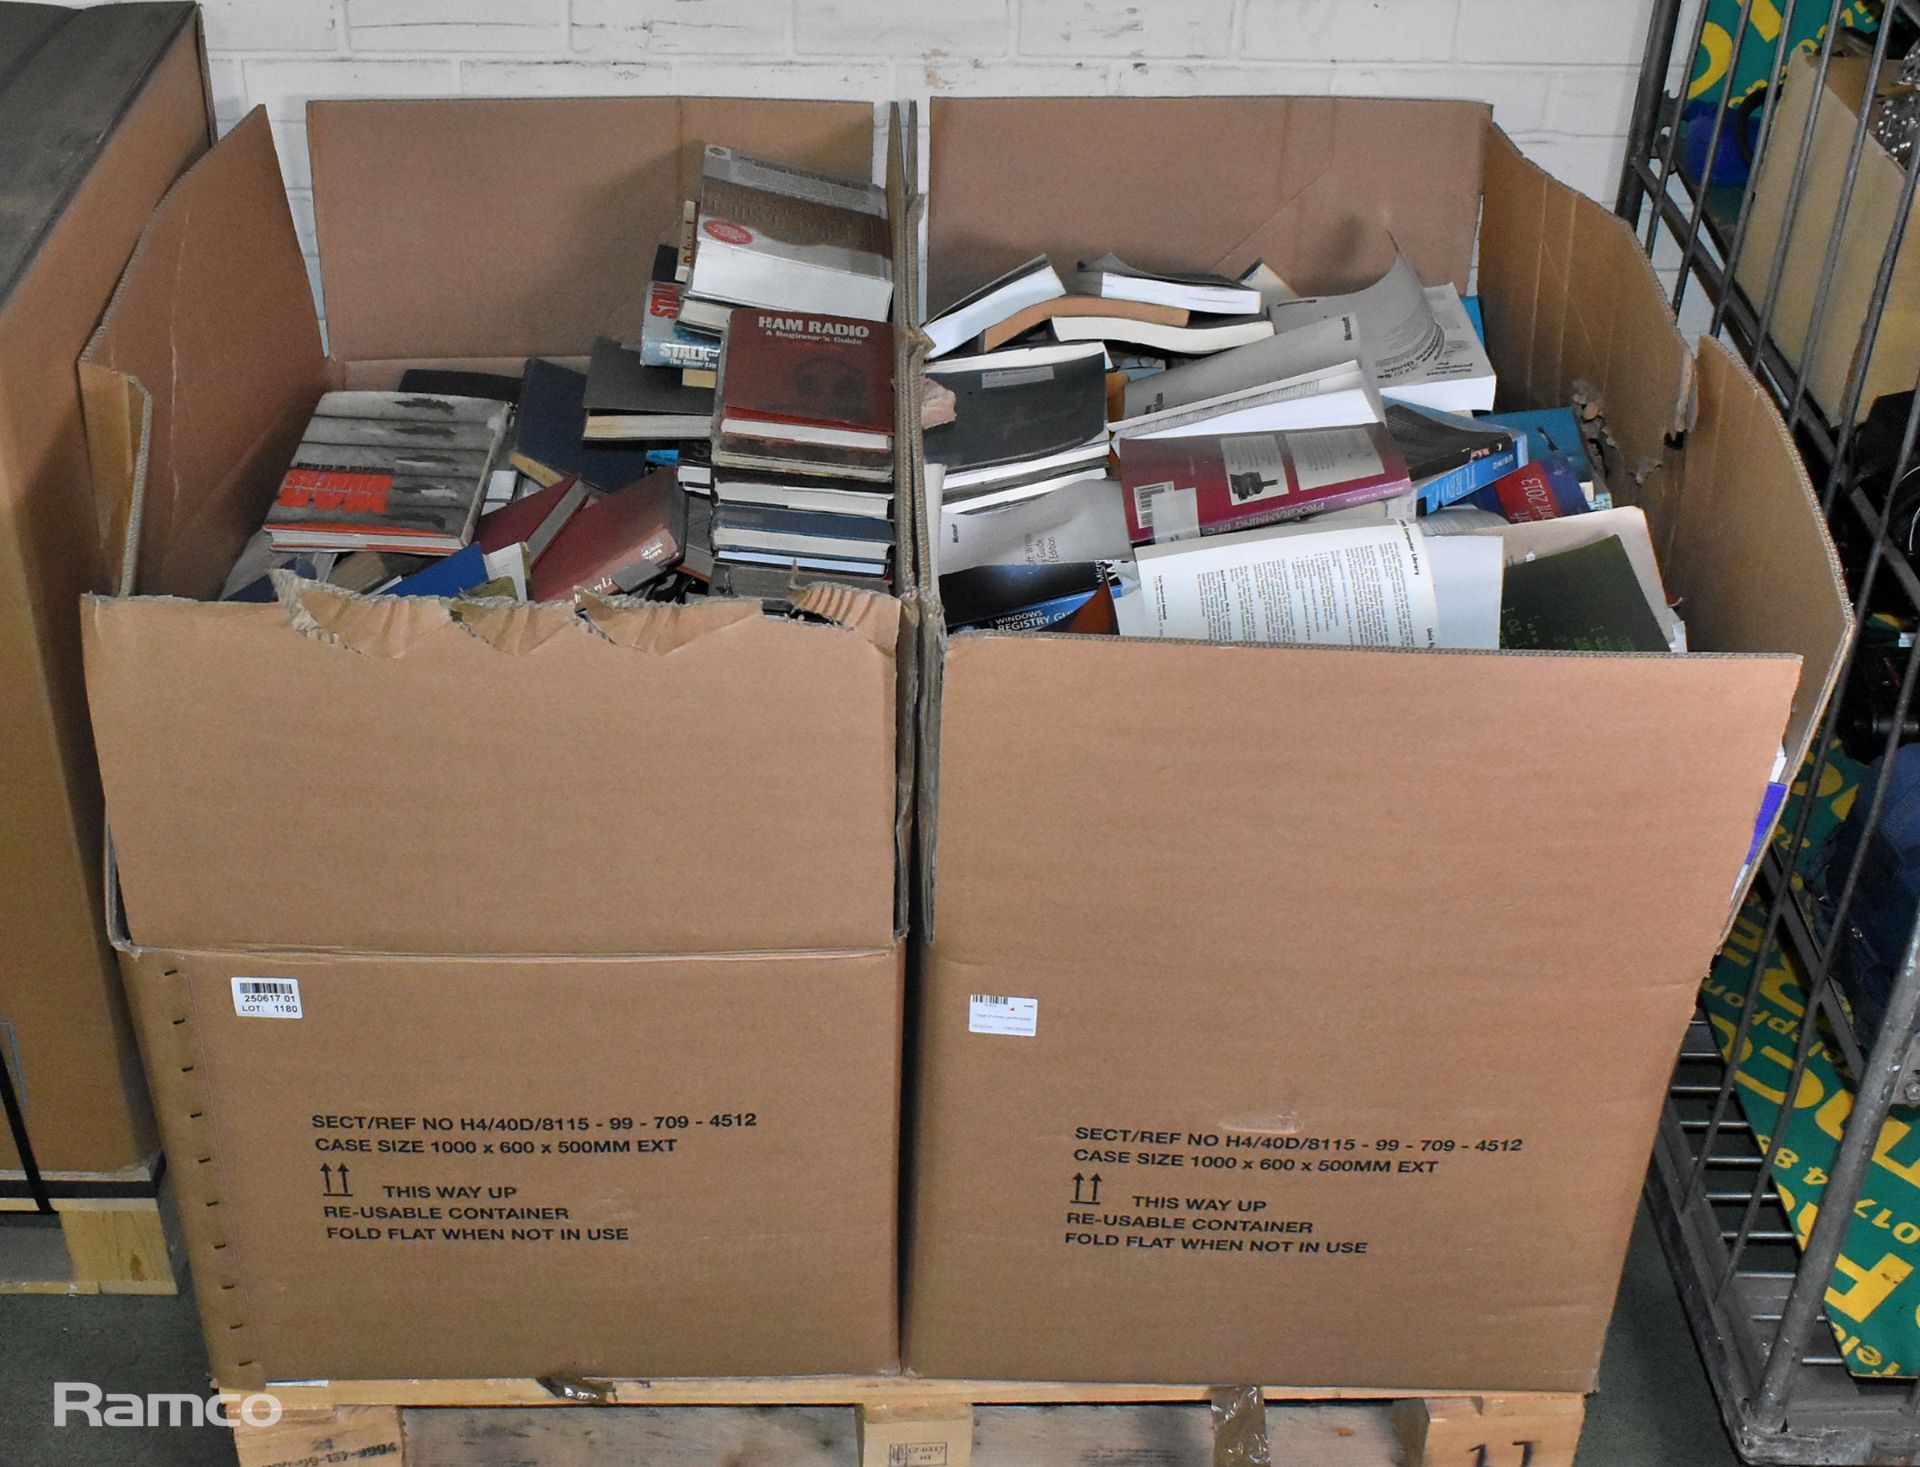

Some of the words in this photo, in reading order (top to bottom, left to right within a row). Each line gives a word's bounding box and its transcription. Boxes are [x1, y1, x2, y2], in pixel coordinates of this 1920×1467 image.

[758, 316, 804, 332] HAM
[808, 320, 870, 338] RADIO
[1520, 476, 1546, 505] 2013
[1233, 502, 1325, 530] PROGRAMMING
[1218, 523, 1233, 534] IN
[995, 610, 1043, 625] WINDOWS
[997, 615, 1050, 633] REGISTRY
[244, 994, 281, 1003] 250617
[284, 995, 296, 1003] 01
[242, 1005, 265, 1013] LOT:
[274, 1005, 298, 1013] 1180
[312, 1115, 416, 1130] SECT/REF
[422, 1118, 453, 1131] NO
[461, 1118, 589, 1131] H4/40D/8115
[609, 1117, 633, 1130] 99
[654, 1116, 689, 1129] 709
[709, 1113, 756, 1127] 4512
[315, 1138, 372, 1152] CASE
[378, 1140, 424, 1153] SIZE
[431, 1141, 476, 1153] 1000
[500, 1141, 535, 1153] 600
[558, 1141, 630, 1154] 500MM
[637, 1139, 677, 1152] EXT
[1075, 1127, 1181, 1144] SECT/REF
[1187, 1133, 1219, 1146] NO
[1226, 1135, 1355, 1150] H4/40D/8115
[1376, 1139, 1399, 1151] 99
[1421, 1140, 1455, 1151] 709
[1475, 1139, 1523, 1152] 4512
[1073, 1149, 1130, 1163] CASE
[1136, 1153, 1184, 1166] SIZE
[1191, 1156, 1237, 1169] 1000
[1260, 1159, 1295, 1171] 600
[1318, 1160, 1391, 1172] 500MM
[1398, 1161, 1439, 1173] EXT
[383, 1185, 431, 1198] THIS
[436, 1186, 481, 1198] WAY
[488, 1187, 517, 1199] UP
[323, 1206, 442, 1219] RE-USABLE
[449, 1208, 568, 1219] CONTAINER
[1132, 1196, 1179, 1209] THIS
[1186, 1198, 1232, 1211] WAY
[1238, 1200, 1267, 1212] UP
[1067, 1212, 1185, 1229] RE-USABLE
[1197, 1218, 1313, 1233] CONTAINER
[327, 1227, 381, 1239] FOLD
[388, 1228, 436, 1240] FLAT
[442, 1228, 504, 1240] WHEN
[512, 1229, 554, 1240] NOT
[561, 1229, 580, 1240] IN
[587, 1228, 628, 1240] USE
[1065, 1233, 1119, 1245] FOLD
[1126, 1236, 1175, 1248] FLAT
[1181, 1238, 1243, 1251] WHEN
[1250, 1240, 1294, 1252] NOT
[1299, 1242, 1319, 1253] IN
[1326, 1242, 1368, 1253] USE
